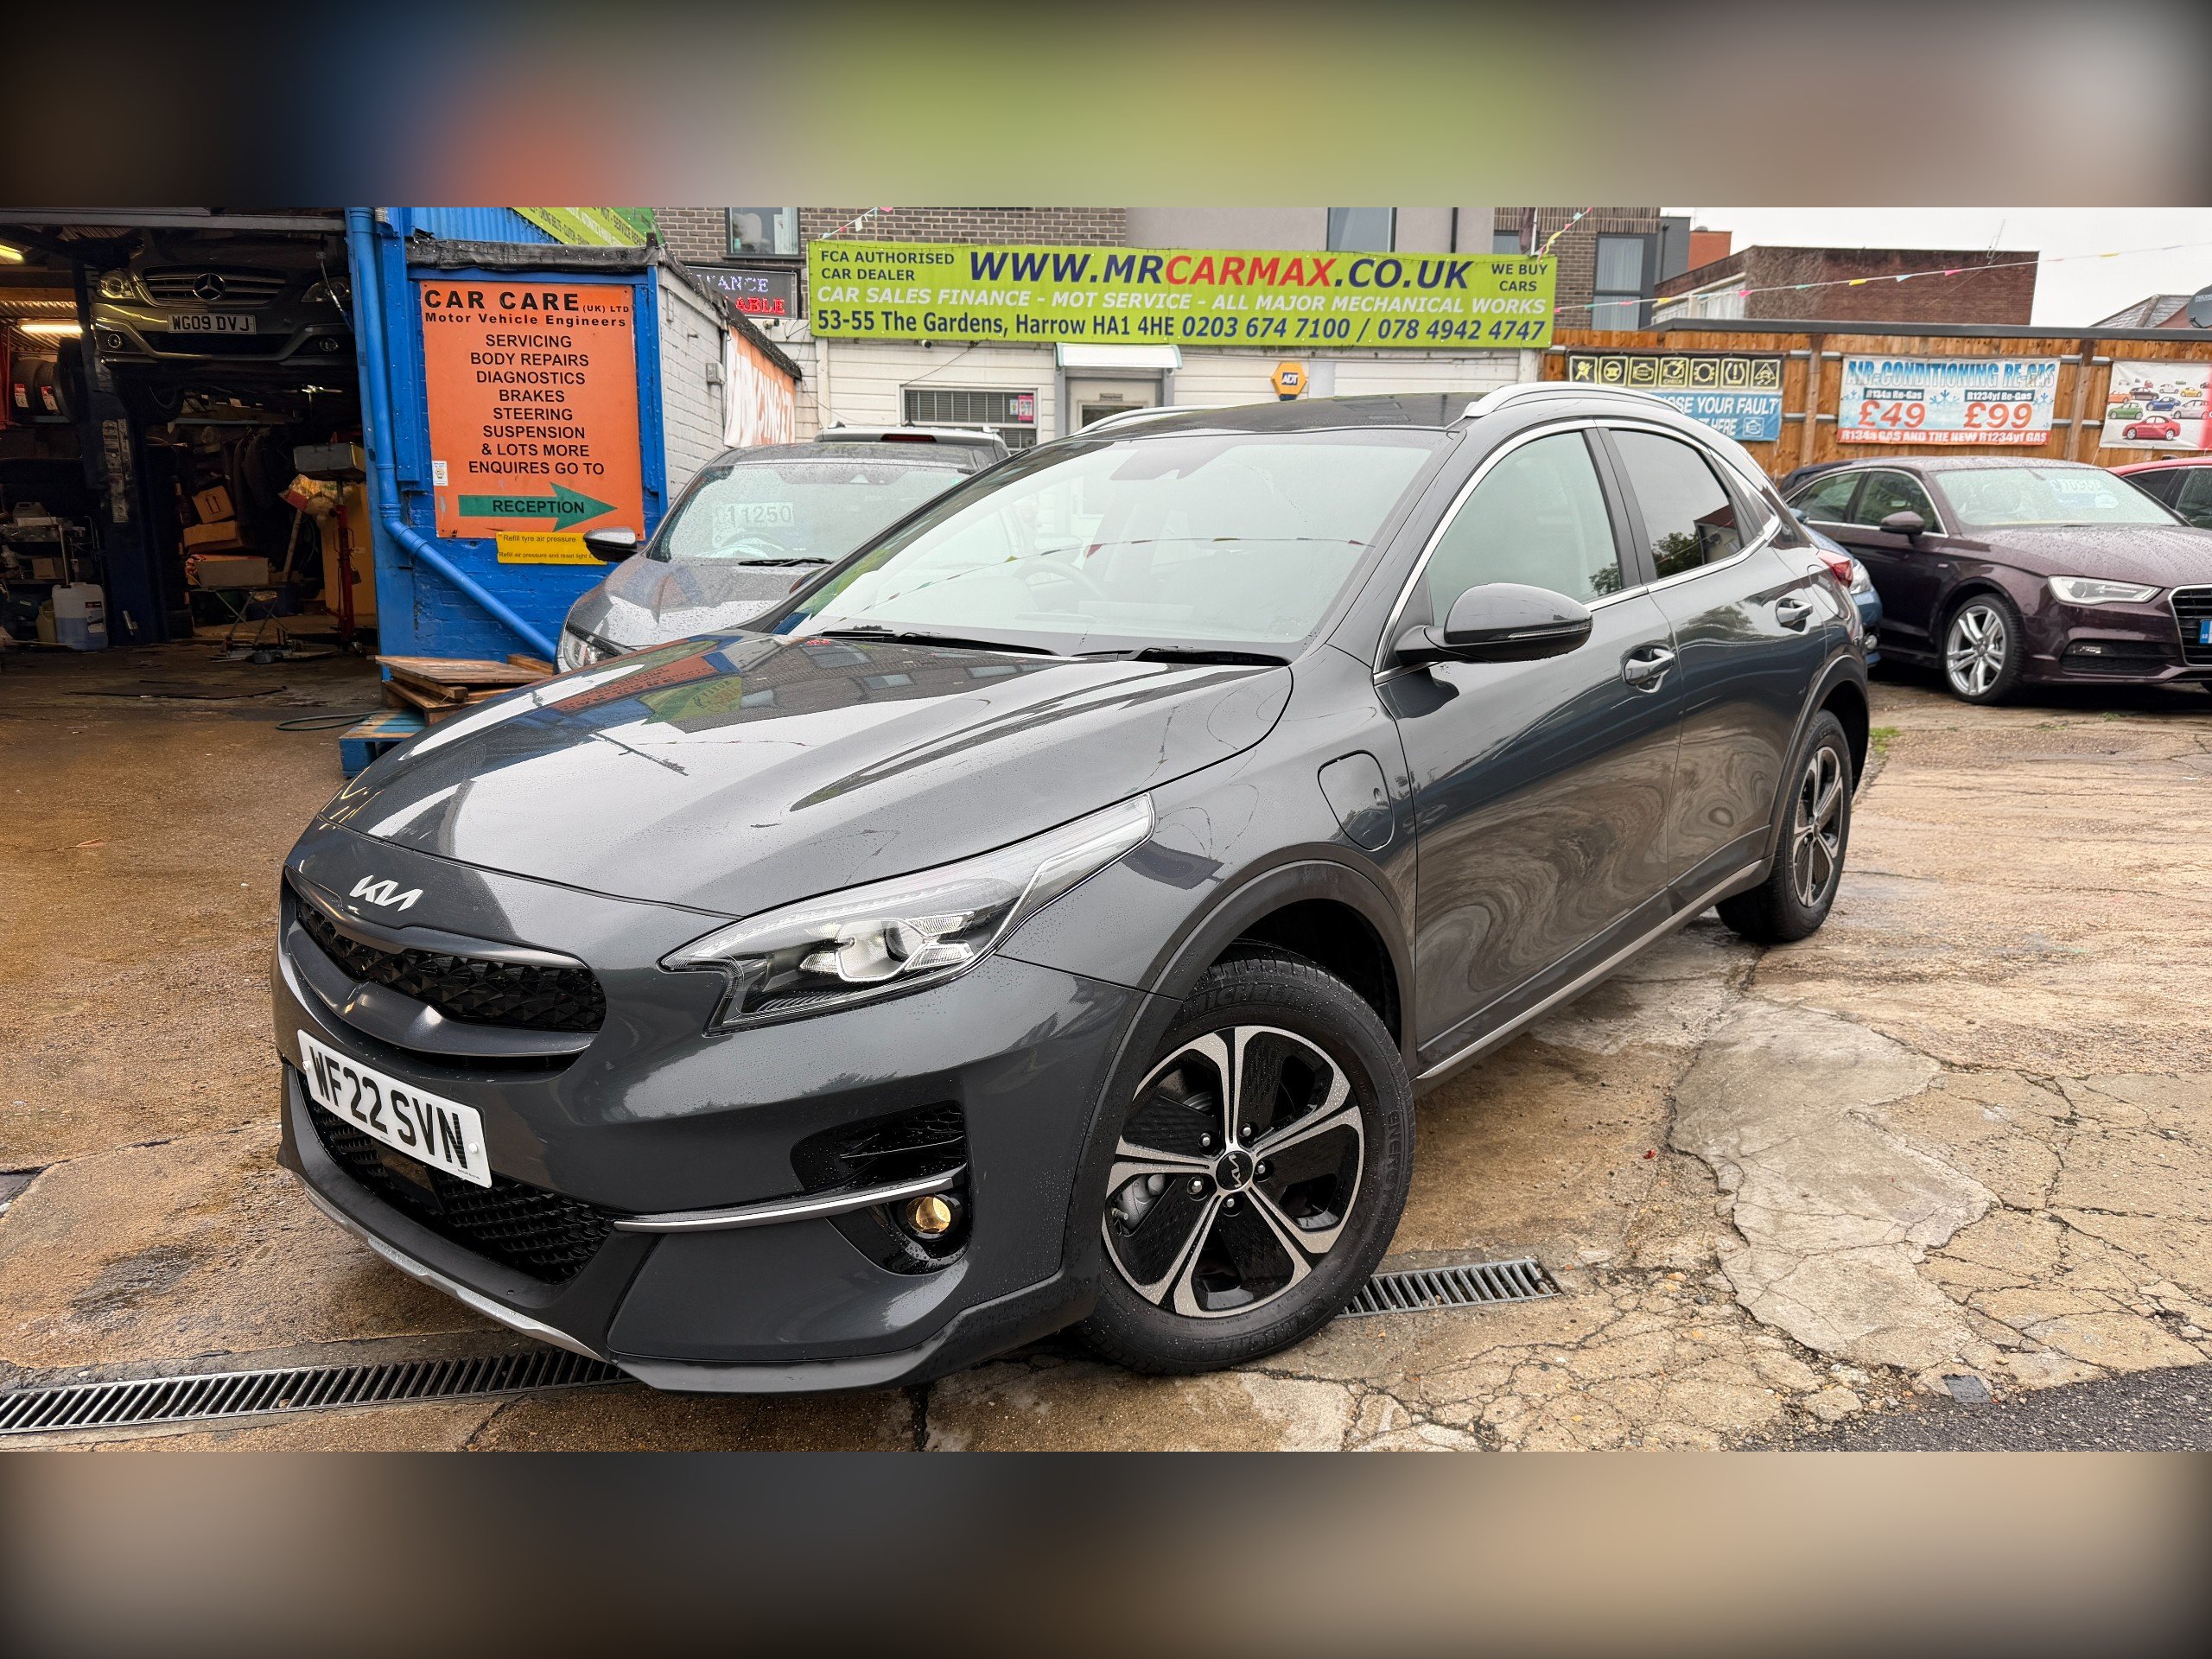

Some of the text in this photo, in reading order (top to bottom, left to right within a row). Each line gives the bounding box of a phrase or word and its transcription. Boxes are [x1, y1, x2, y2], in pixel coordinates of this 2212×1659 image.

[821, 251, 955, 265] FCA AUTHORISED
[821, 268, 916, 281] CAR DEALER
[970, 251, 1474, 289] WWW.MRCARMAX.CO.UK
[1491, 264, 1548, 276] WE BUY
[1499, 280, 1537, 292] CARS
[424, 289, 630, 314] CAR CARE (UK) LTD
[817, 286, 860, 303] CAR
[865, 287, 931, 304] SALES
[938, 289, 1033, 307] FINANCE
[1052, 291, 1099, 308] MOT
[1103, 292, 1192, 309] SERVICE
[1211, 294, 1249, 310] ALL
[1255, 295, 1326, 312] MAJOR
[1331, 296, 1464, 314] MECHANICAL
[1471, 298, 1547, 315] WORKS
[172, 315, 250, 331] WG09 DVJ
[425, 312, 626, 327] Motor Vehicle Engineers
[817, 309, 875, 331] 53-55
[880, 310, 917, 332] The
[923, 312, 1009, 338] Gardens,
[1016, 314, 1086, 334] Harrow
[1093, 315, 1130, 336] HA1
[1137, 315, 1174, 336] 4HE
[1182, 316, 1238, 338] 0203
[1245, 316, 1287, 339] 674
[1294, 317, 1351, 339] 7100
[1377, 318, 1420, 339] 078
[1426, 319, 1482, 340] 4942
[1488, 320, 1546, 341] 4747
[486, 334, 572, 348] SERVICING
[470, 353, 589, 366] BODY REPAIRS
[476, 371, 586, 385] DIAGNOSTICS
[1281, 373, 1299, 385] ADT
[1846, 360, 2056, 389] AIR-CONDITIONING RE-GAS
[499, 389, 565, 403] BRAKES
[1697, 397, 1735, 415] YOUR
[1736, 397, 1780, 415] FAULT
[493, 407, 573, 421] STEERING
[1858, 399, 1926, 429] £49
[1963, 401, 2034, 429] £99
[482, 425, 585, 439] SUSPENSION
[1878, 432, 1901, 442] GAS
[1902, 432, 1927, 442] AND
[1928, 432, 1950, 442] THE
[1950, 432, 1979, 442] NEW
[2025, 432, 2048, 442] GAS
[481, 443, 590, 457] & LOTS MORE
[468, 461, 605, 475] ENQUIRES GO TO
[493, 499, 585, 514] RECEPTION
[521, 535, 535, 543] tyre
[348, 874, 424, 912] KIA
[308, 1044, 469, 1171] WF22 SVN
